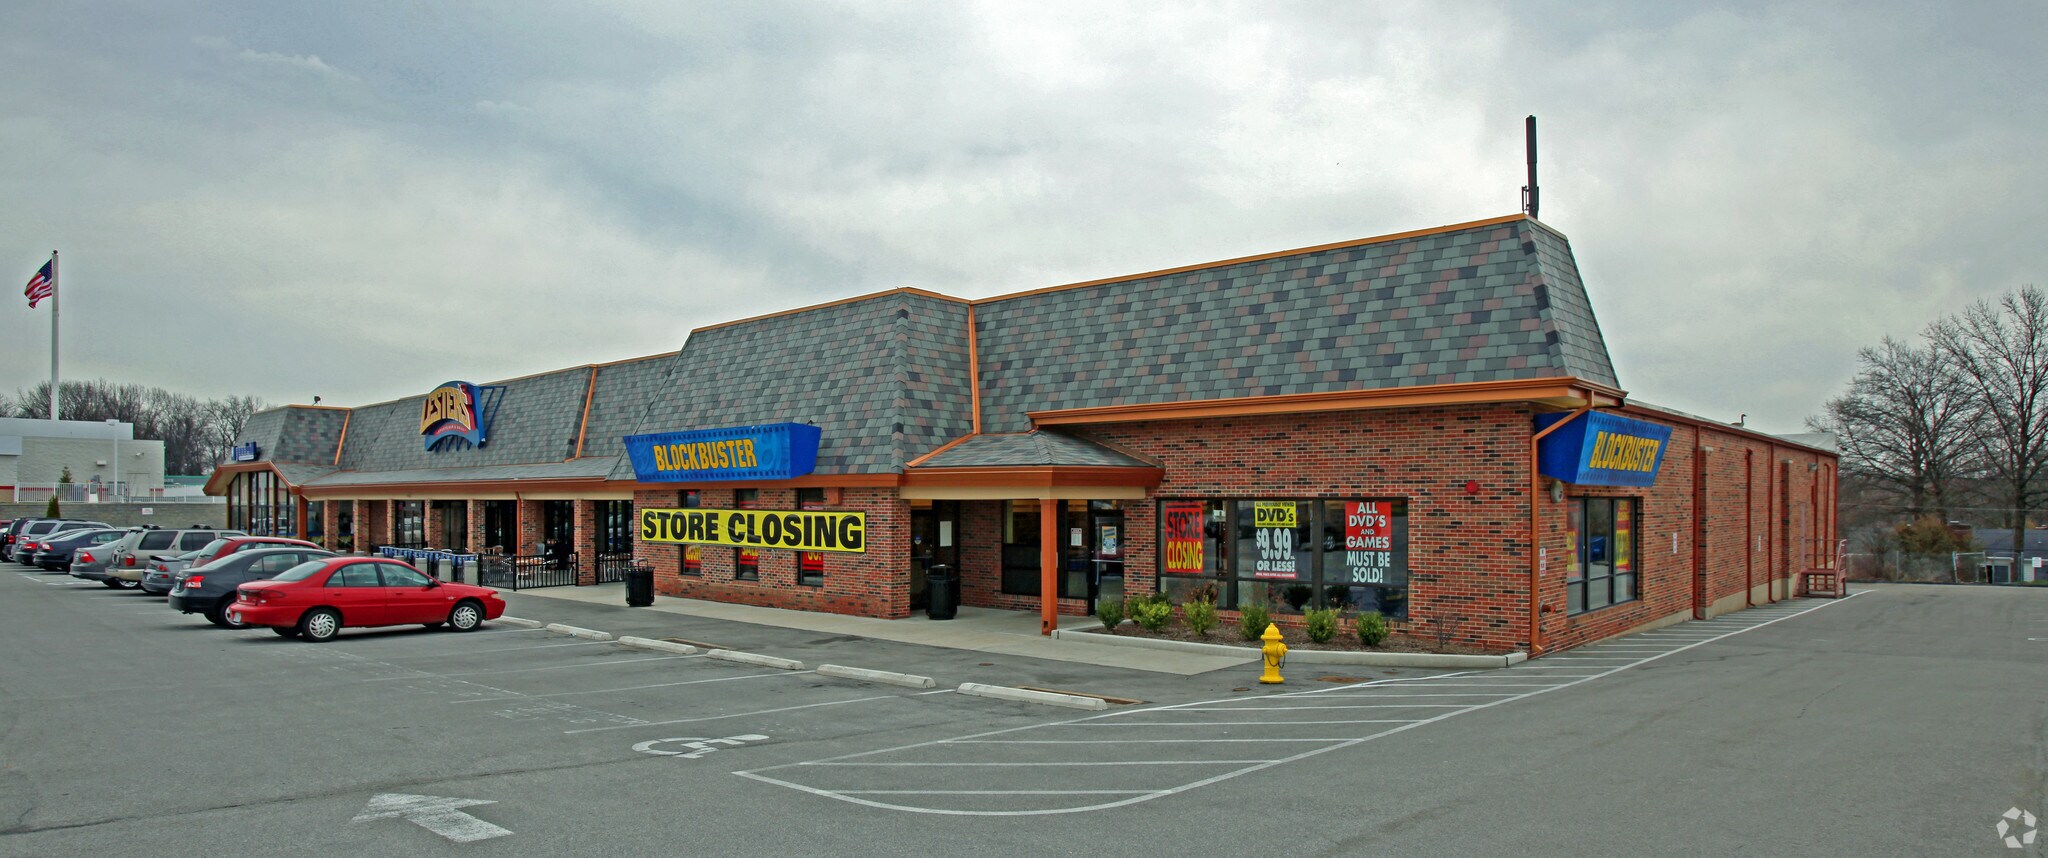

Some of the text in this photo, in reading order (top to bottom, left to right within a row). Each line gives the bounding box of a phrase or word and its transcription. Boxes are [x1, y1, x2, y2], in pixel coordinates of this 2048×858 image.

[653, 439, 758, 471] BLOCKBUSTER
[1590, 431, 1659, 472] BLOCKBUSTER
[1257, 508, 1294, 522] DVD's
[1357, 502, 1378, 514] ALL
[642, 510, 862, 550] STORE CLOSING
[1168, 511, 1200, 539] STORE
[1349, 515, 1386, 528] DVD'S
[1256, 528, 1292, 560] $9.99
[1346, 536, 1390, 549] GAMES
[1167, 541, 1203, 570] CLOSING
[1346, 551, 1390, 567] MUST BE
[1257, 560, 1295, 572] OR LESS!
[1352, 567, 1383, 584] SOLD!
